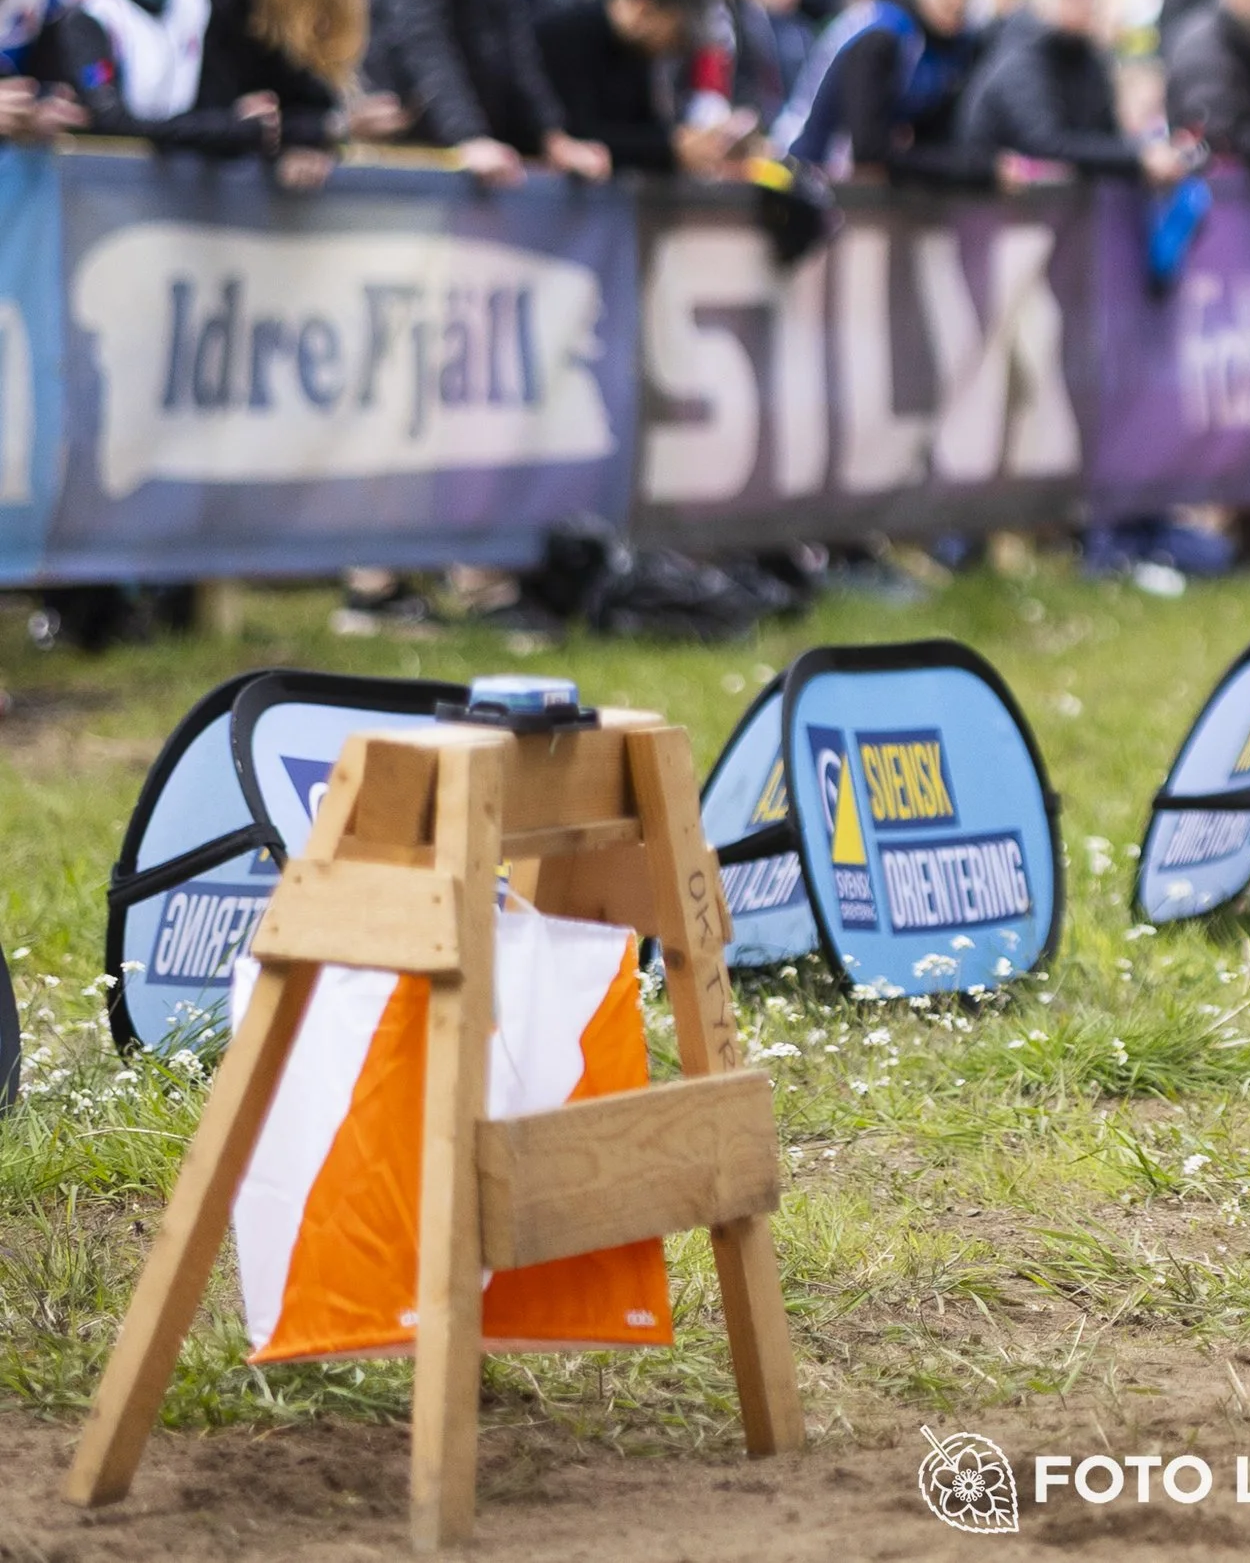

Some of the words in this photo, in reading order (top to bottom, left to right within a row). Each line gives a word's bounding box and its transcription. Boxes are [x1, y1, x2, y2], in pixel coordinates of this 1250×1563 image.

[861, 742, 954, 820] SVENSK
[688, 869, 714, 950] OK
[883, 839, 1029, 928] ORIENTERING
